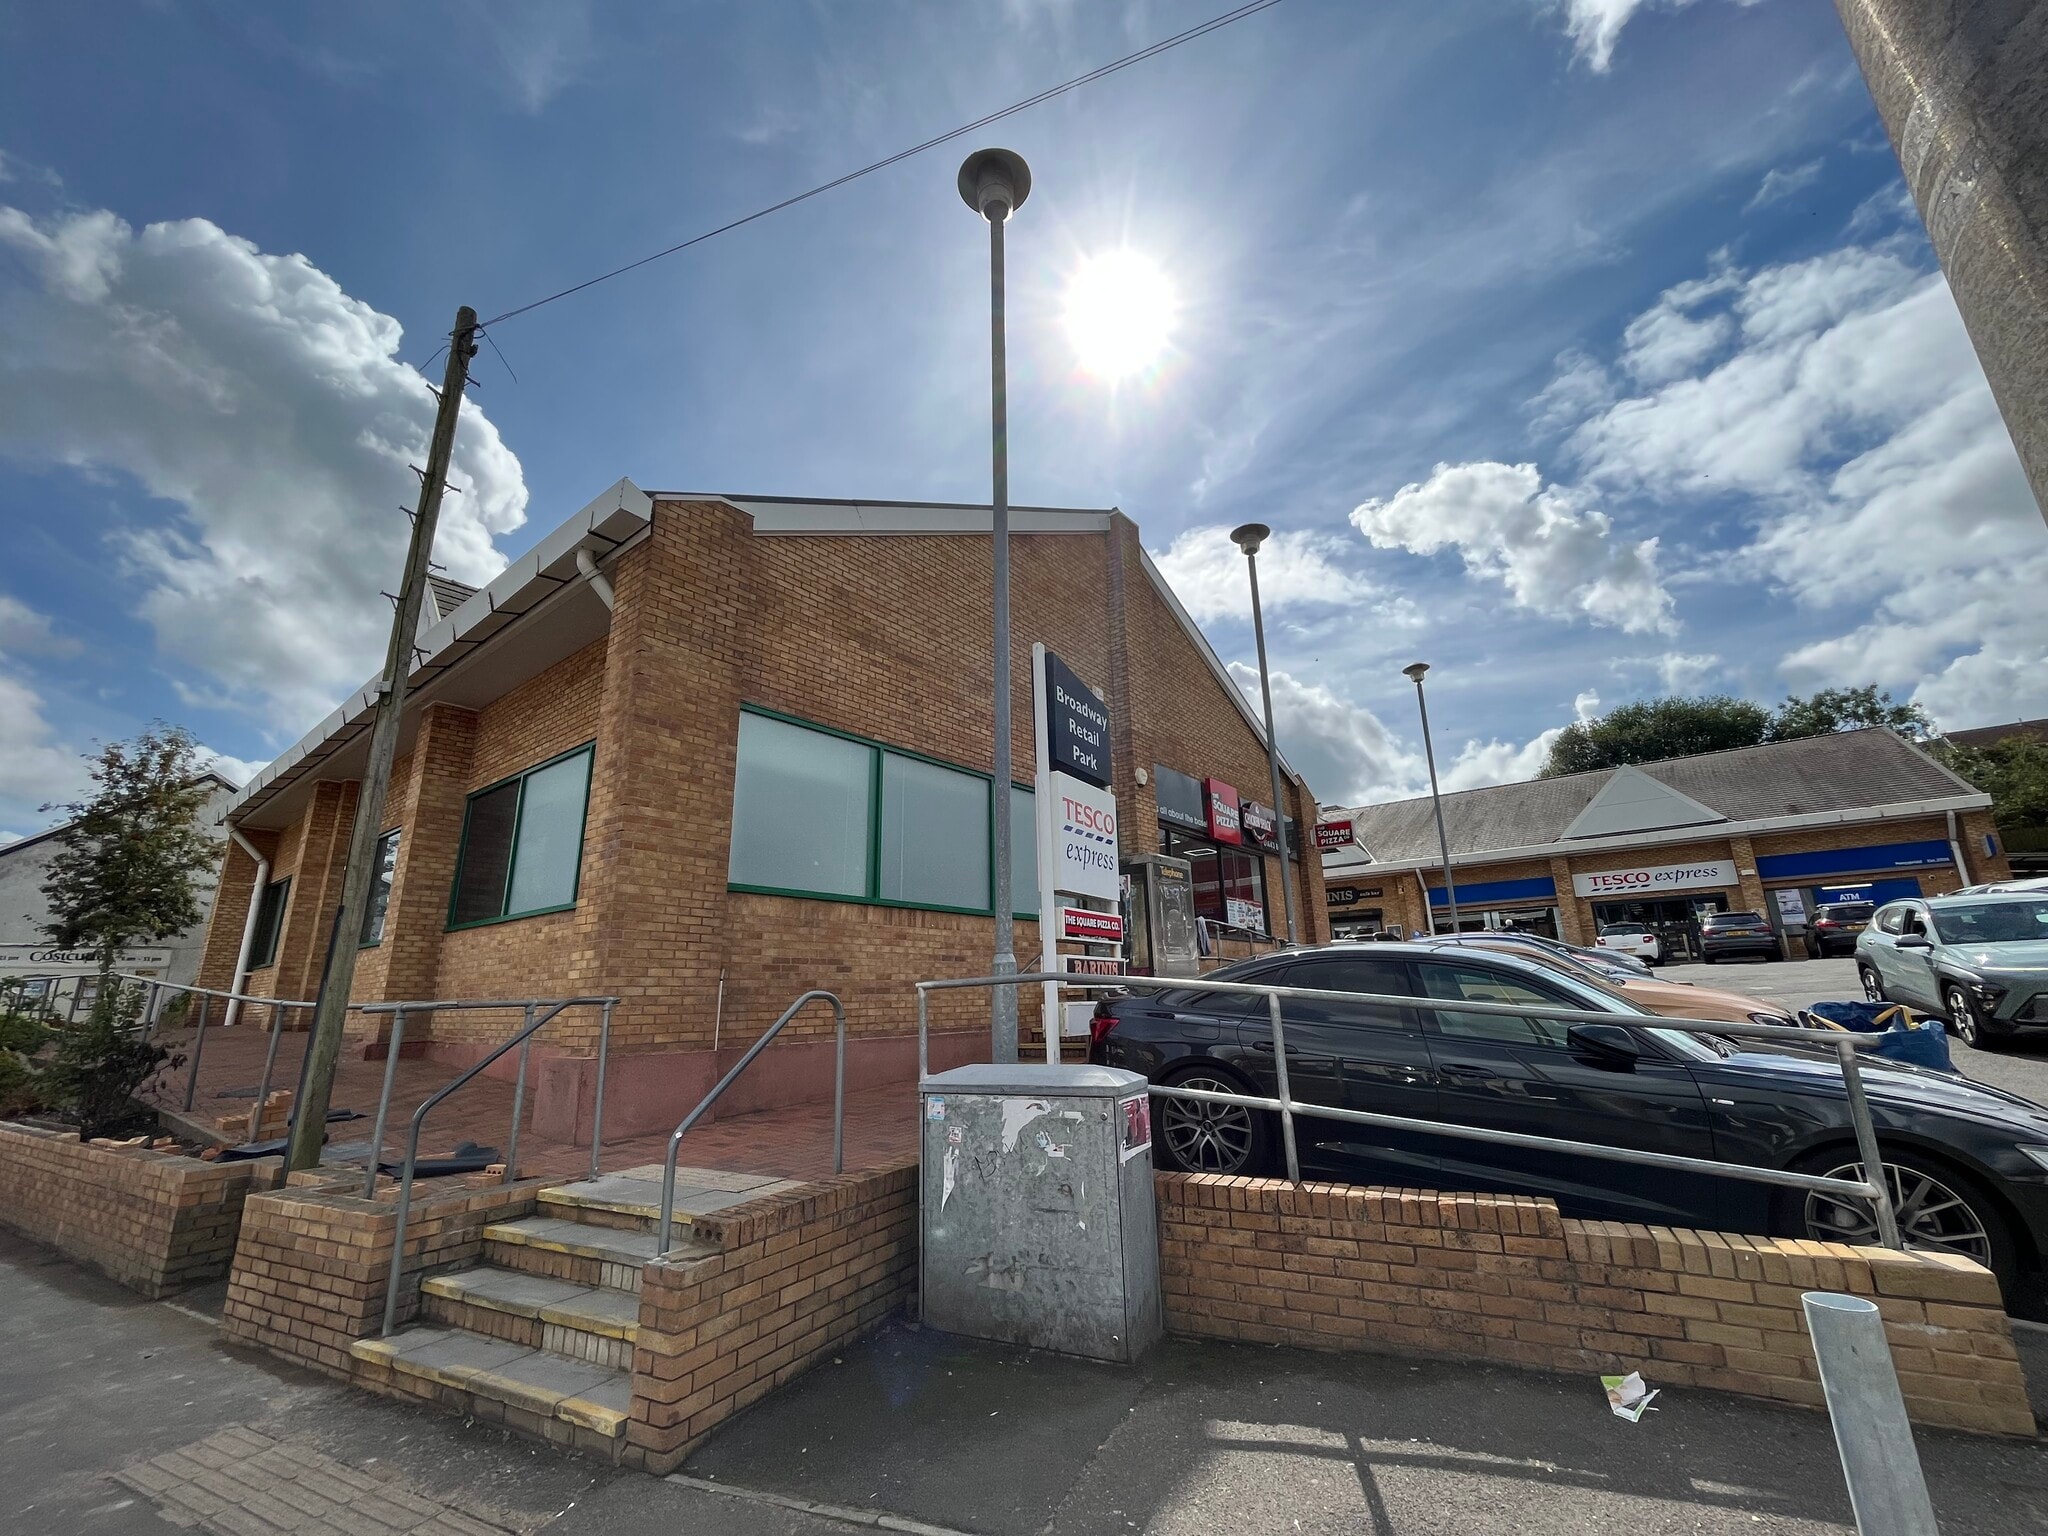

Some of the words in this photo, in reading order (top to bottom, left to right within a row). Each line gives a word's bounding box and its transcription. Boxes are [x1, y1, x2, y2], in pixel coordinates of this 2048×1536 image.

[1056, 685, 1108, 732] Broadway
[1069, 717, 1100, 748] Retail
[1073, 744, 1098, 771] Park
[1062, 796, 1115, 835] TESCO
[1159, 806, 1168, 816] all
[1168, 808, 1184, 820] about
[1184, 812, 1194, 824] the
[1212, 799, 1240, 821] SQUARE
[1215, 814, 1236, 829] PIZZA
[1317, 829, 1350, 837] SQUARE
[1321, 836, 1345, 845] PIZZA
[1066, 842, 1114, 871] express
[1159, 865, 1185, 880] Telephone
[1588, 872, 1651, 887] TESCO
[1654, 867, 1719, 884] express
[1839, 892, 1860, 901] ATM
[1065, 914, 1076, 925] THE
[1076, 916, 1097, 928] SQUARE
[1097, 919, 1111, 930] PIZZA
[1073, 959, 1119, 976] BARINIS
